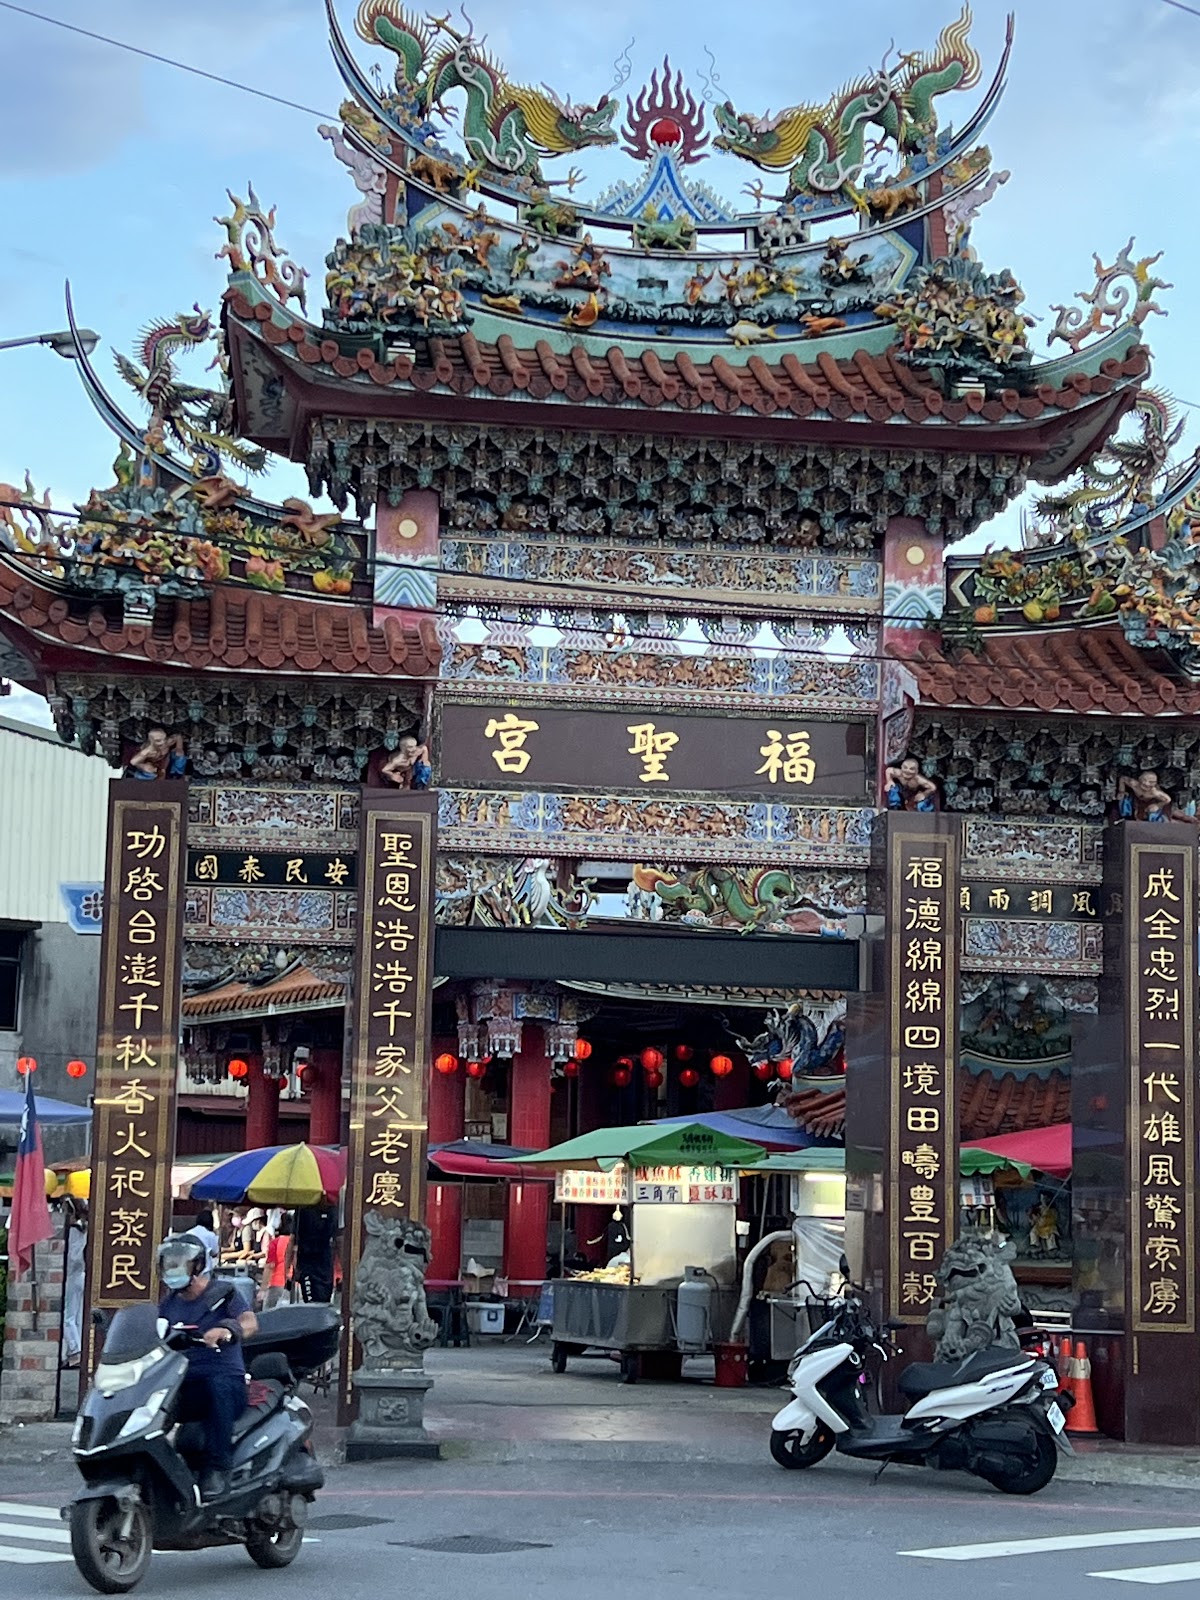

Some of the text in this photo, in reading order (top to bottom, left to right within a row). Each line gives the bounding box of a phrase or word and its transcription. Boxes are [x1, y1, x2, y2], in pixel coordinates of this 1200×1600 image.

[196, 855, 349, 885] 國泰民安
[638, 1185, 679, 1202] 三角骨
